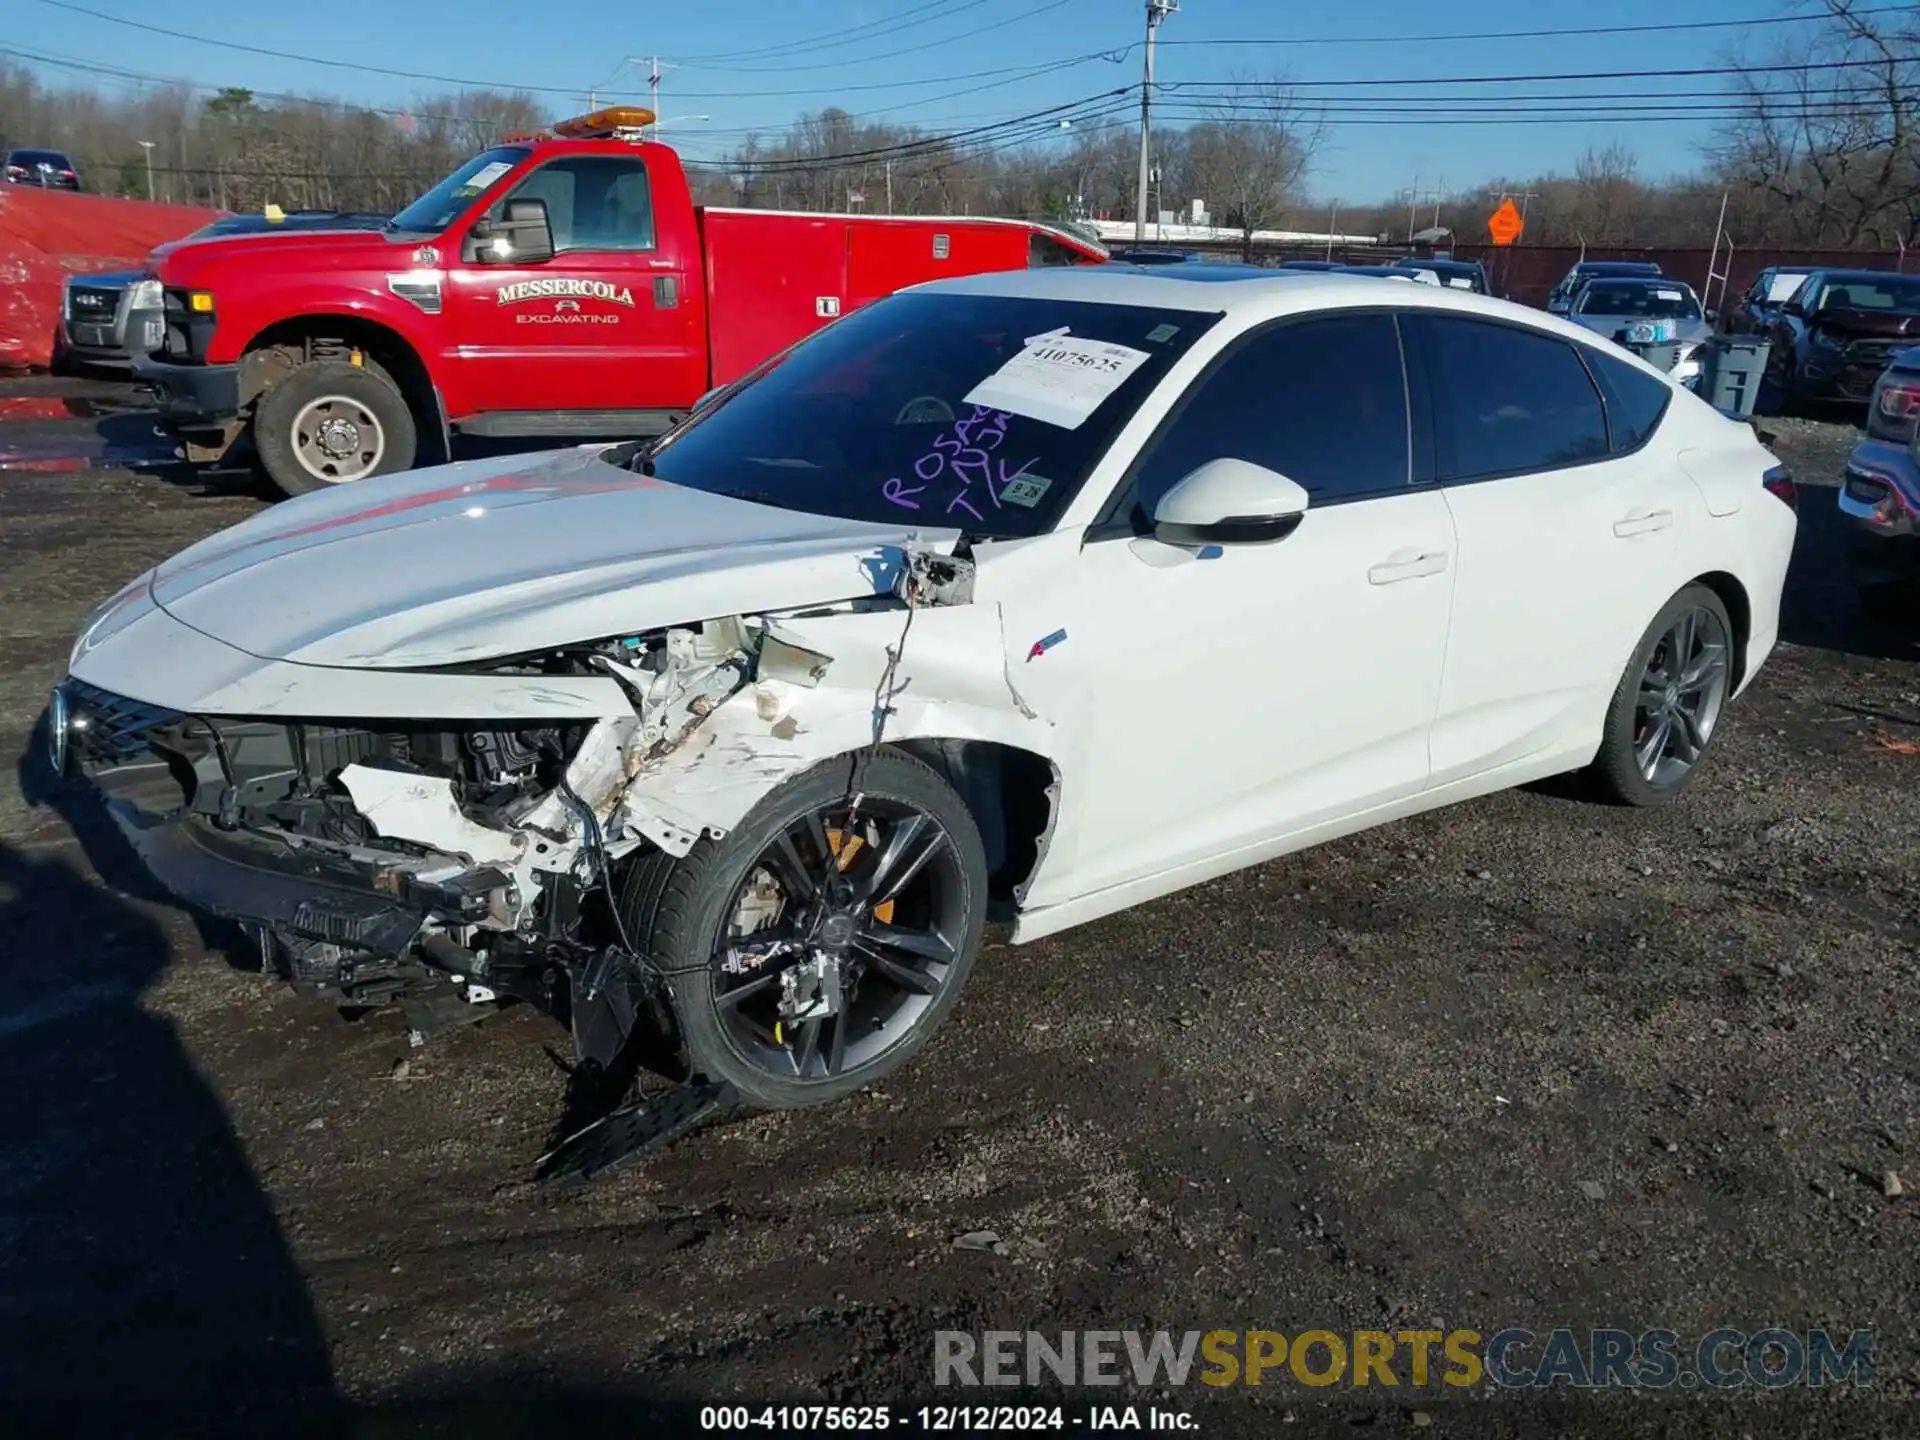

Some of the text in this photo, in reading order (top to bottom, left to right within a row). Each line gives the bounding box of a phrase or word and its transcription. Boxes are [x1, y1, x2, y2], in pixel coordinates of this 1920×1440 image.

[497, 279, 634, 308] MESSERCOLA
[516, 314, 619, 324] EXCAVATING
[1033, 347, 1122, 373] 41075625
